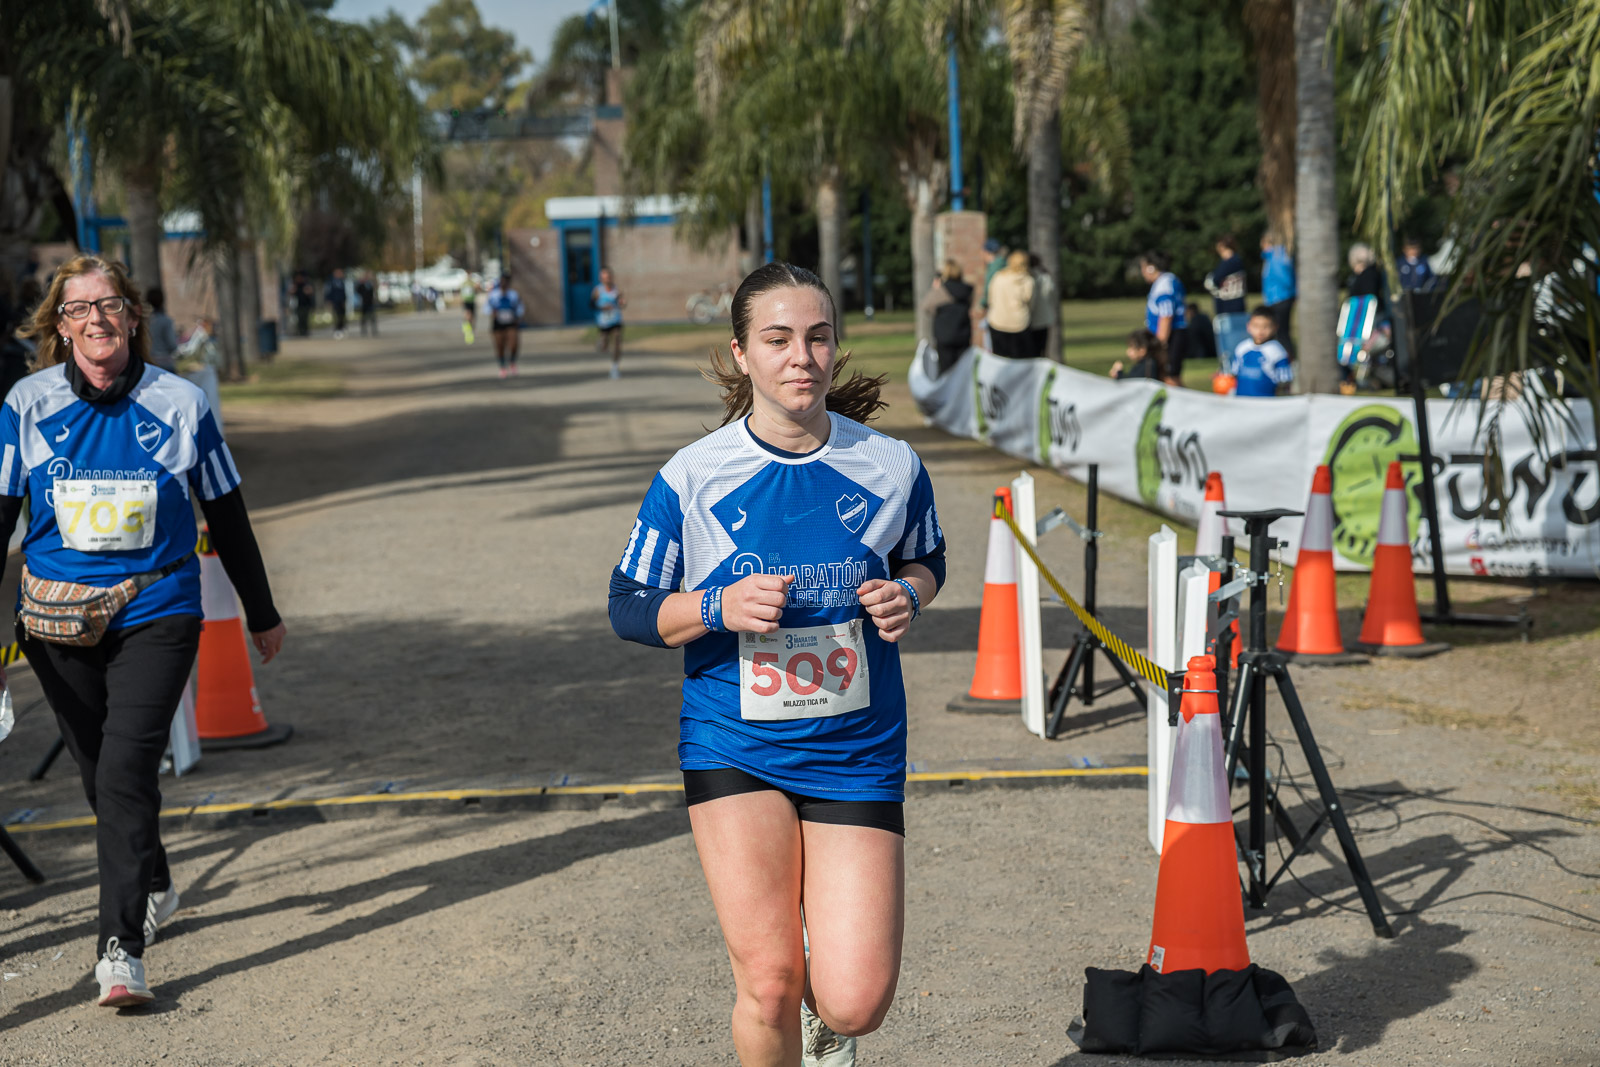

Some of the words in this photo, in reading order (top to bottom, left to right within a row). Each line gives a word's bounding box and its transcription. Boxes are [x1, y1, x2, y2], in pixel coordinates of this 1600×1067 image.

[63, 500, 145, 534] 705
[785, 633, 794, 650] 3
[793, 635, 818, 644] MARATÓN
[750, 647, 858, 697] 509
[807, 698, 819, 706] TICA
[819, 697, 829, 705] PIA
